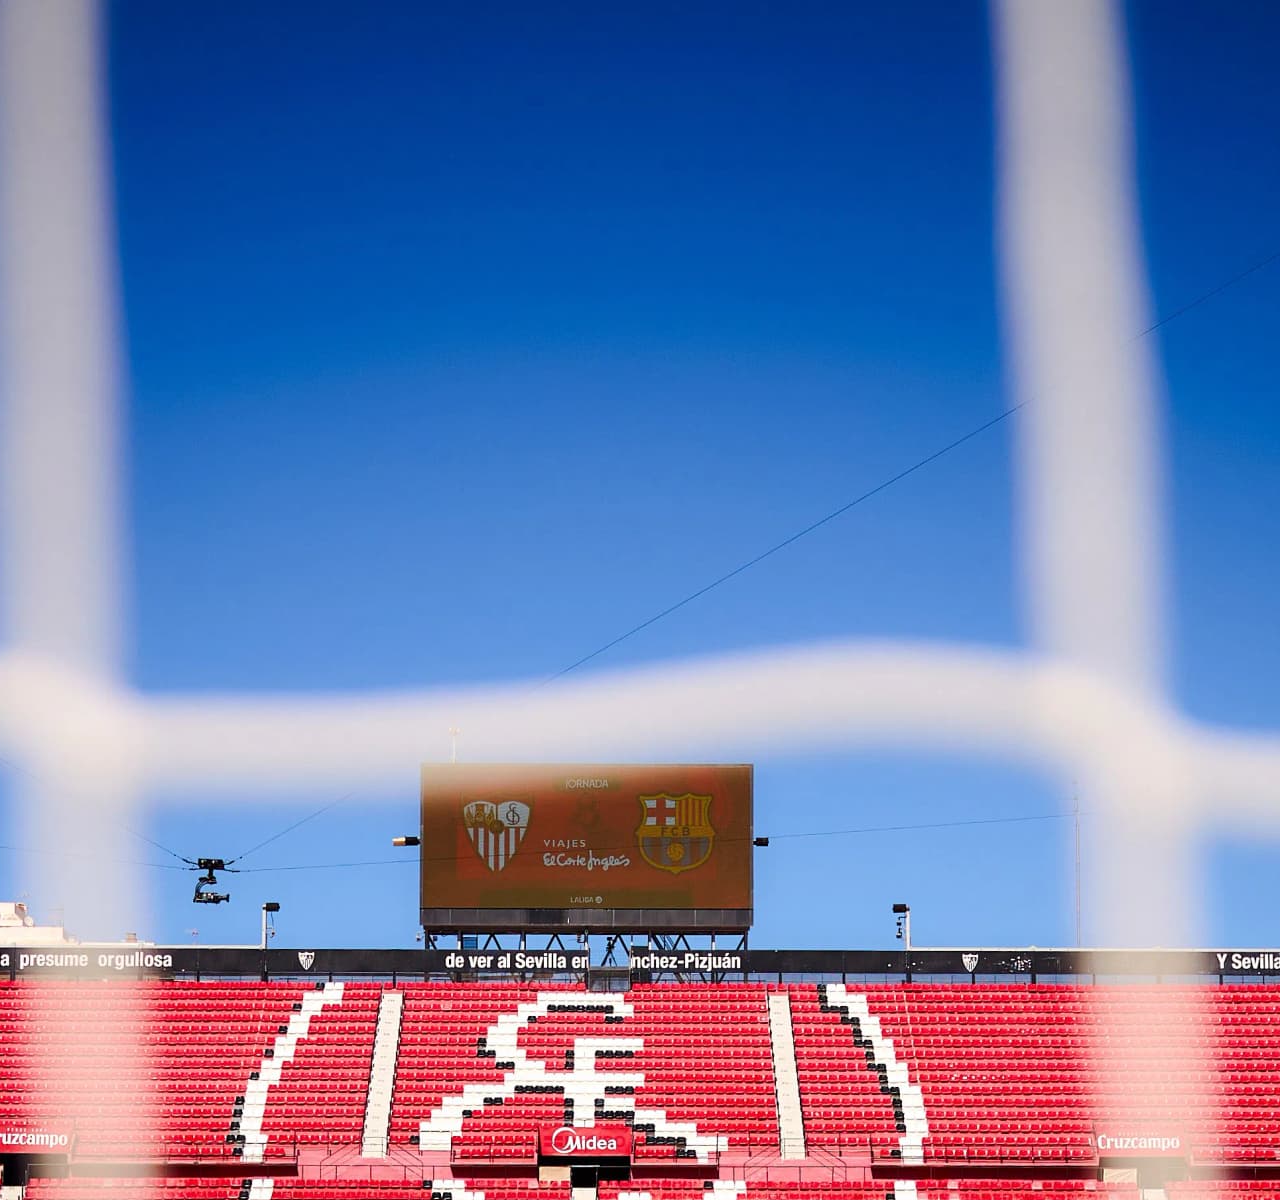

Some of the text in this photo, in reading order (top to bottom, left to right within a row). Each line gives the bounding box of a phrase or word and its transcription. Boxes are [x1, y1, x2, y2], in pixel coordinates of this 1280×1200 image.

[543, 839, 587, 850] VIAJES
[19, 953, 88, 970] presume
[98, 951, 172, 970] orgullosa
[445, 952, 464, 969] de
[469, 956, 491, 969] ver
[497, 952, 511, 969] al
[515, 952, 567, 969] Sevilla
[1216, 953, 1227, 970] Y
[558, 1131, 617, 1151] Midea
[1097, 1134, 1181, 1151] Cruzcampo
